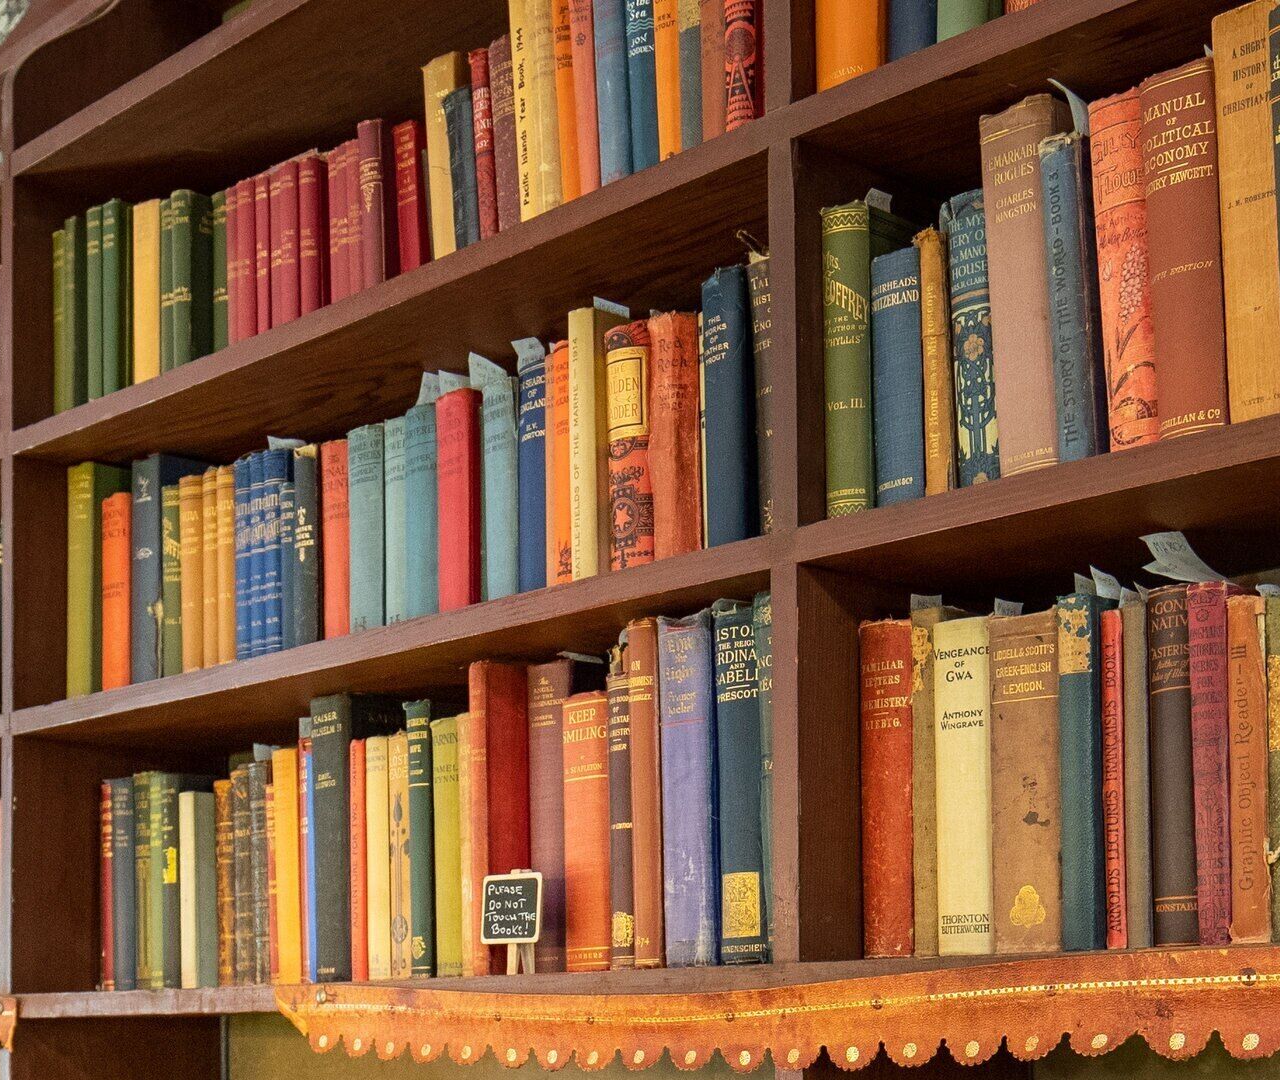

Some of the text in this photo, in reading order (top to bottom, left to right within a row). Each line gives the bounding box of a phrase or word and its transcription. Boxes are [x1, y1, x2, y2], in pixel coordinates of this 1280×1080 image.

[631, 33, 648, 47] JON
[518, 57, 526, 90] Book,
[1232, 60, 1268, 83] HISTORY
[1144, 92, 1206, 125] MANUAL
[1166, 117, 1177, 126] OF
[993, 161, 1035, 187] ROGUES
[995, 188, 1034, 210] CHARLES
[1050, 183, 1062, 226] BOOK
[994, 201, 1036, 224] KINGSTON
[1052, 238, 1066, 292] WORLD
[1056, 295, 1069, 328] THE
[1061, 332, 1071, 354] OF
[1061, 357, 1076, 405] STORY
[1062, 409, 1078, 448] THE
[729, 662, 746, 670] AND
[954, 660, 966, 670] OF
[945, 670, 974, 683] GWA
[568, 708, 596, 725] KEEP
[942, 708, 984, 720] ANTHONY
[940, 719, 985, 732] WINGRAVE
[563, 724, 607, 745] SMILING
[488, 884, 523, 896] PLEASE
[489, 898, 526, 911] DO NOT
[485, 911, 536, 922] TOUCH THE
[941, 912, 990, 925] THORNTON
[491, 922, 528, 935] BOOKS!
[941, 924, 990, 936] BUTTERWORTH
